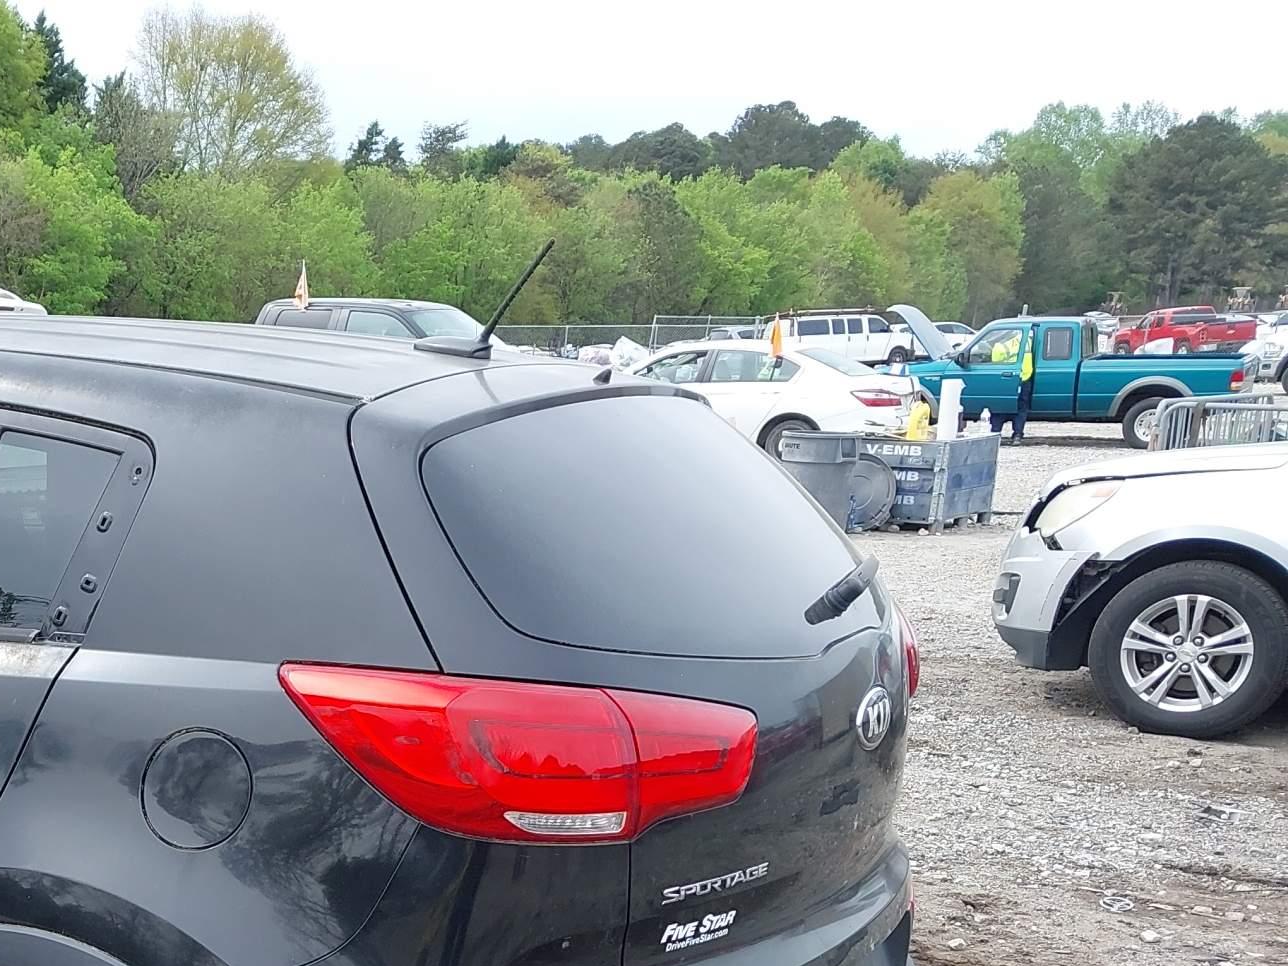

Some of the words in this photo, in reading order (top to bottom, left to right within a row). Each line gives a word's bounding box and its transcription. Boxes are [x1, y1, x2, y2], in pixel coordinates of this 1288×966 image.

[866, 443, 922, 456] V-EMB
[893, 470, 919, 481] MB
[661, 862, 769, 905] SPORTAGE
[660, 921, 699, 944] FIVE
[699, 910, 737, 933] STAR
[665, 928, 729, 953] DriveFiveStar.com
